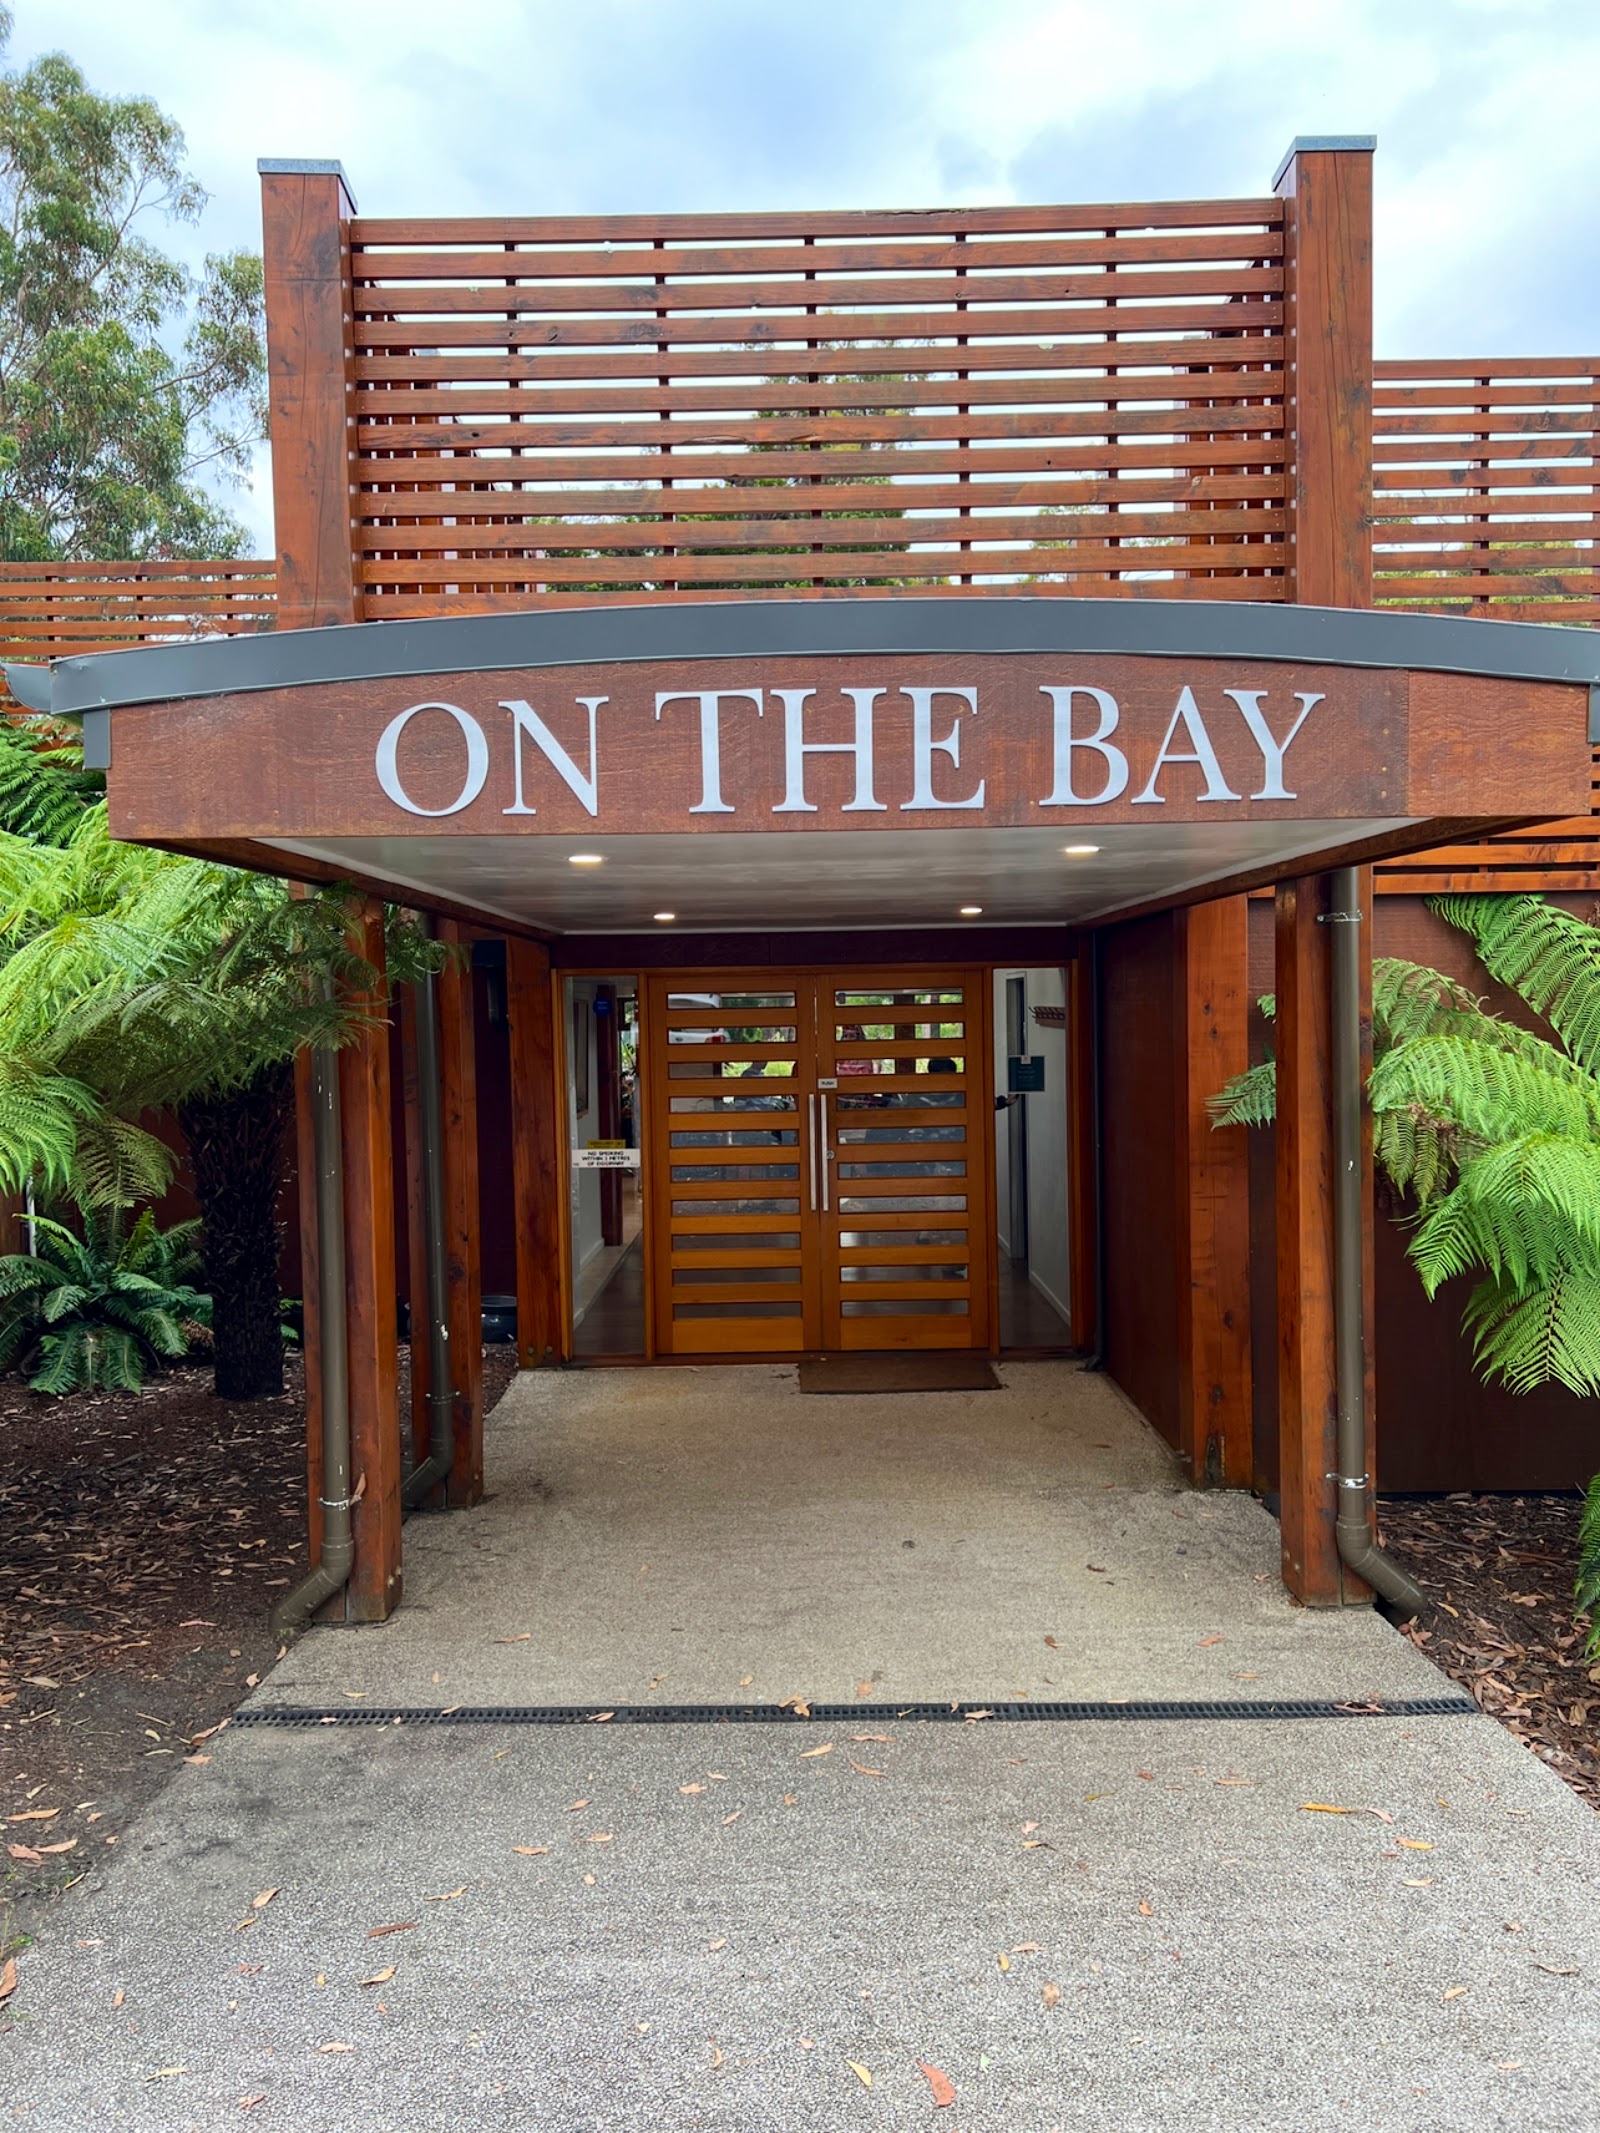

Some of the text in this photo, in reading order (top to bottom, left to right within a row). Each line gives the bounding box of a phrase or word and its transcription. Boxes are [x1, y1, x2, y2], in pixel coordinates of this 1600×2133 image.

[375, 685, 1326, 816] ON THE BAY
